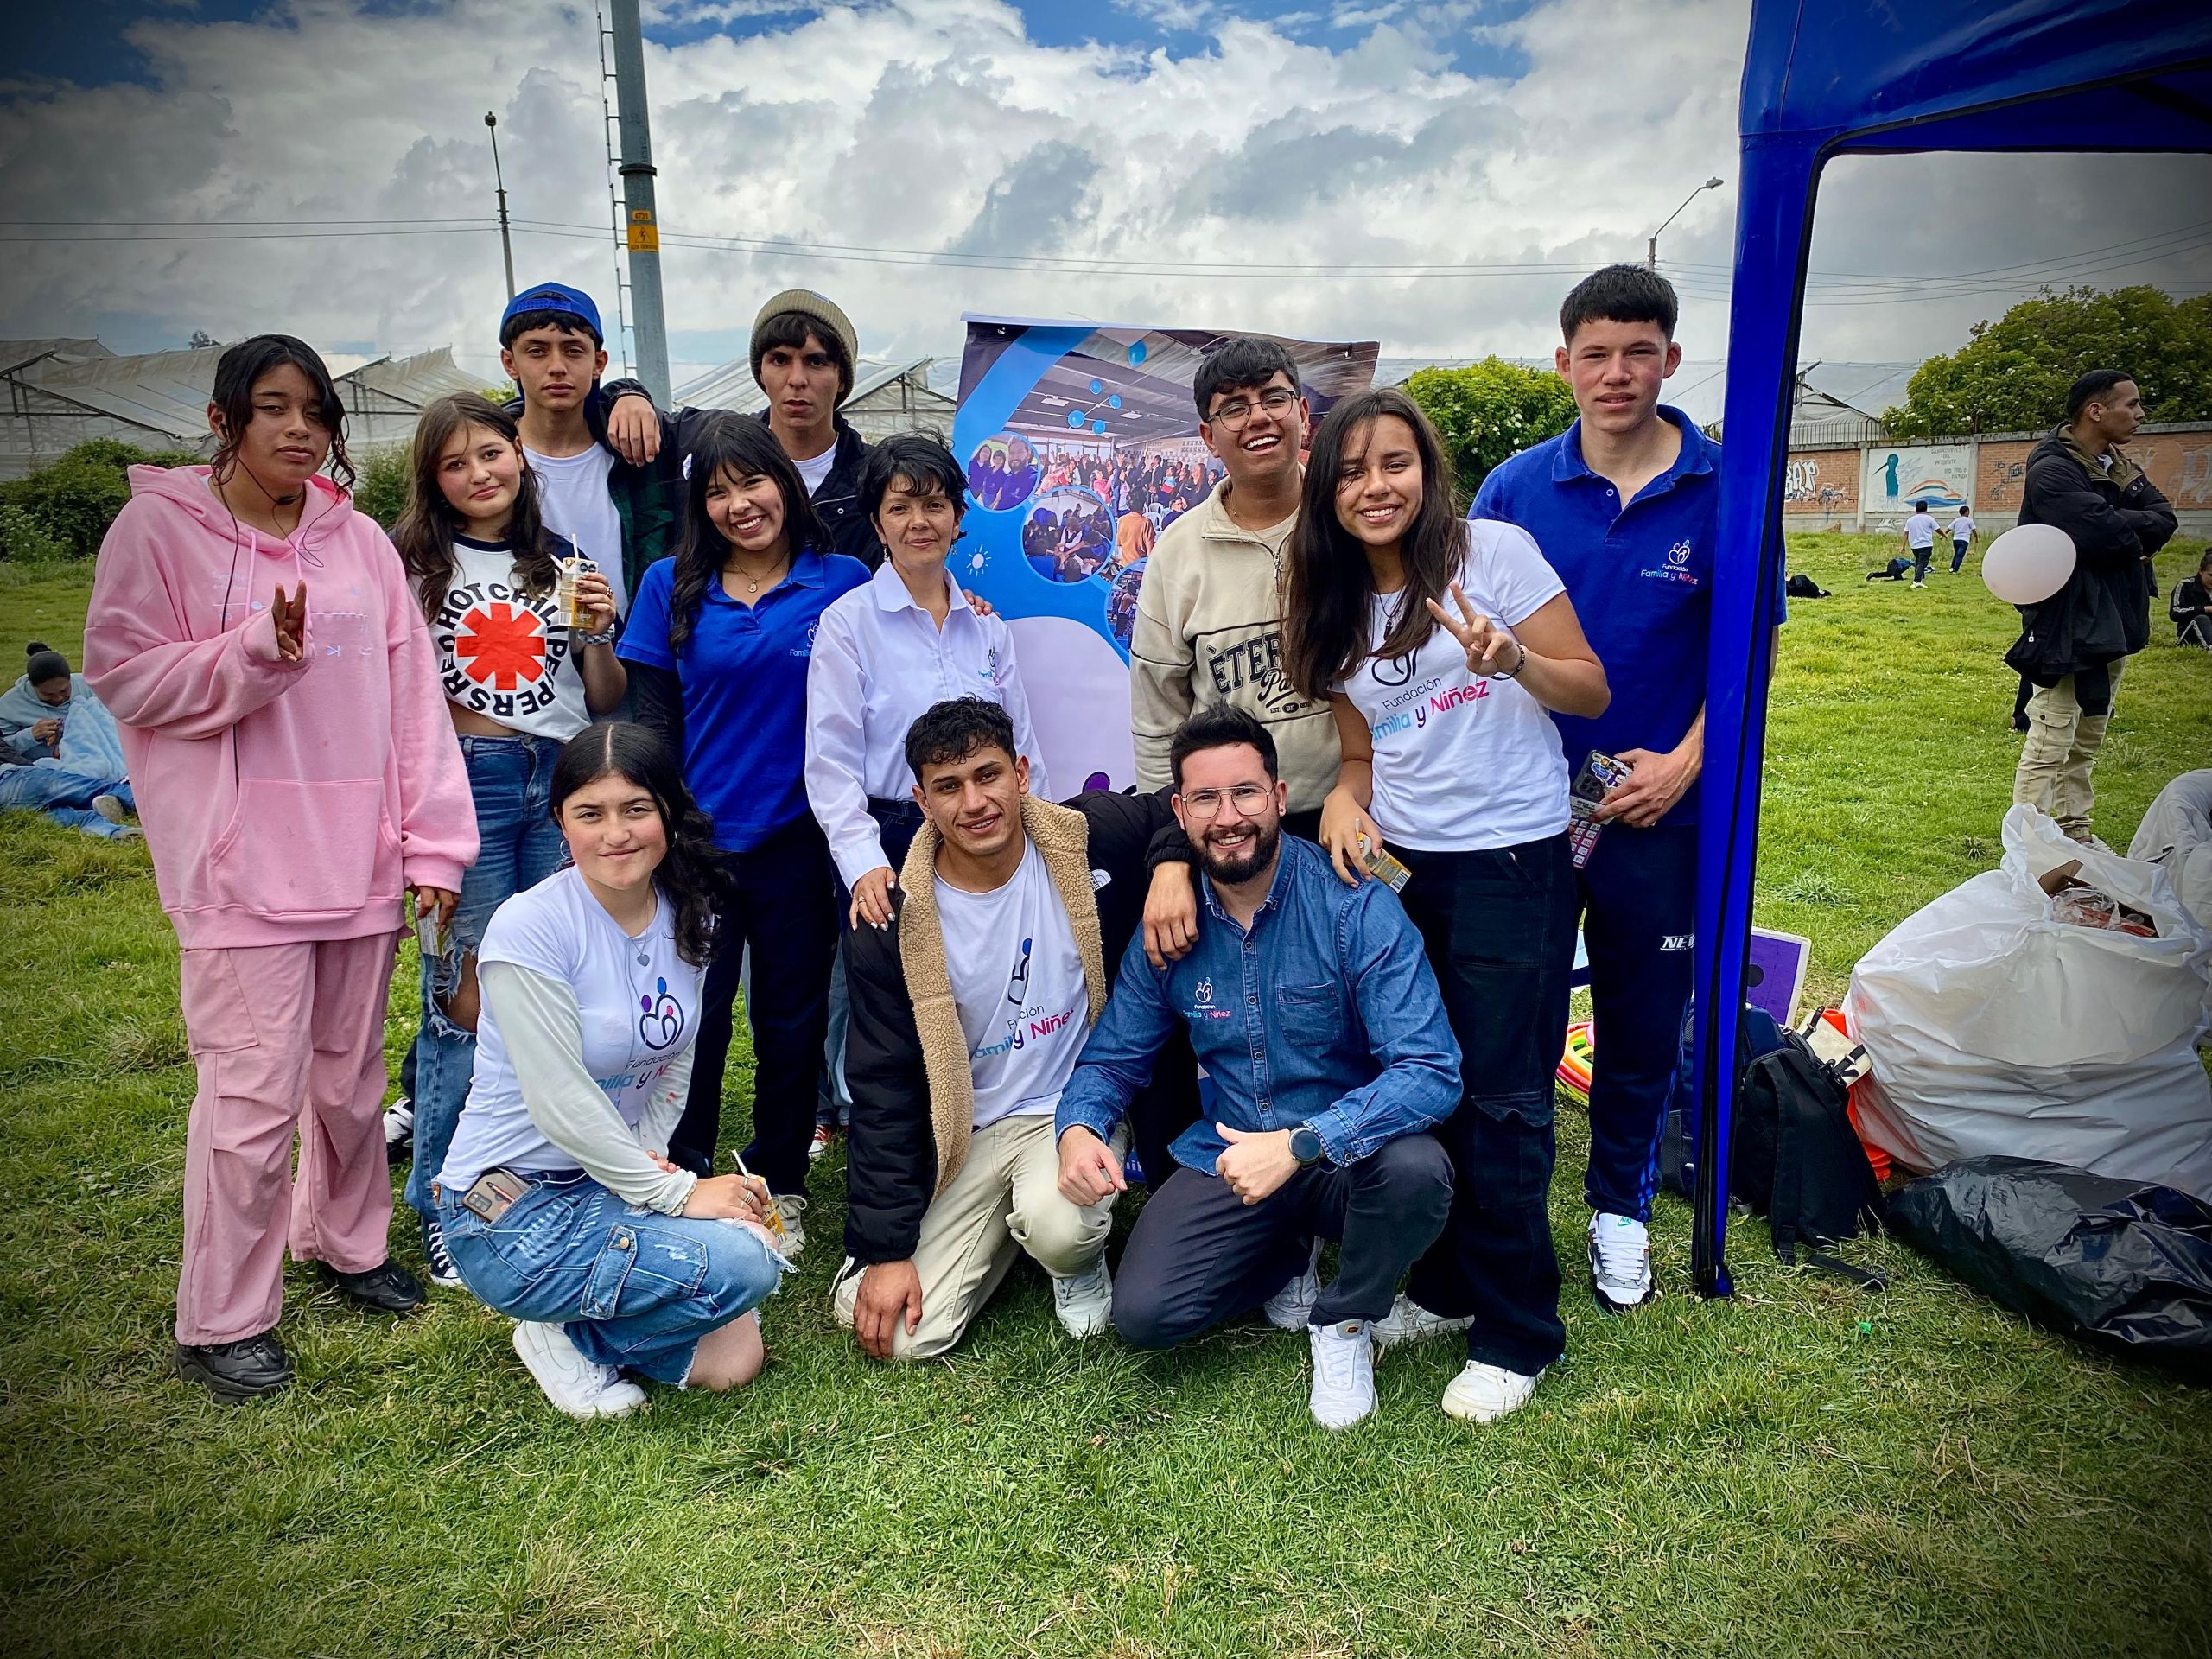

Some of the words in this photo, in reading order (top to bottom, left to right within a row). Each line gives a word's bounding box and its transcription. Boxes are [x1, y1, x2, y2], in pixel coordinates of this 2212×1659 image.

[435, 582, 485, 629] HOT
[1370, 713, 1412, 741] milia
[1415, 706, 1427, 728] y
[1430, 680, 1490, 715] Niñez
[1382, 676, 1442, 711] Fundación
[1013, 1029, 1025, 1050] y
[1029, 1007, 1074, 1040] Niñe
[625, 1052, 680, 1070] Fundación
[636, 1071, 652, 1089] y
